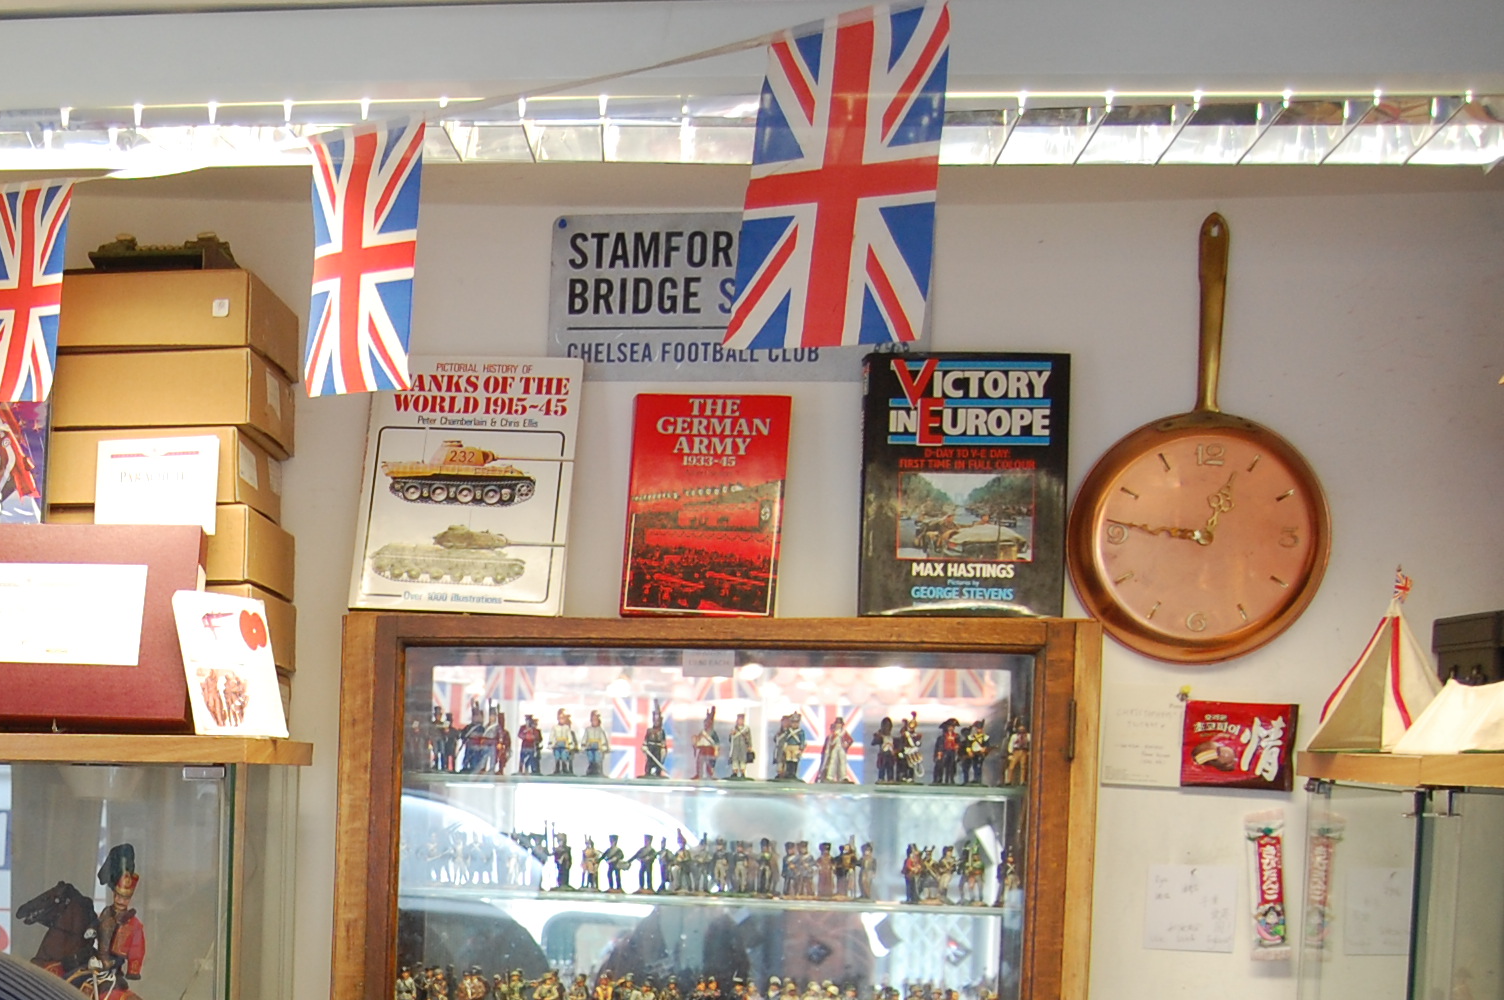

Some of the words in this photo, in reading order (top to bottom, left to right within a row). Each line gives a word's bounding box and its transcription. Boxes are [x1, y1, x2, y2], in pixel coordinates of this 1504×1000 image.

[568, 230, 736, 270] STAMFOR
[568, 277, 702, 315] BRIDGE
[567, 342, 653, 363] CHELSEA
[661, 342, 760, 363] FOOTBALL
[768, 345, 820, 363] CLUB
[436, 362, 478, 373] PICTORIAL
[483, 364, 518, 374] HISTORY
[522, 365, 533, 374] OF
[408, 374, 479, 393] ANKS
[483, 376, 515, 395] OF
[519, 377, 571, 396] THE
[891, 358, 1052, 410] VICTORY
[394, 394, 480, 415] WORLD
[689, 398, 741, 416] THE
[417, 415, 437, 425] Peter
[440, 416, 487, 427] Chamberlain
[490, 418, 497, 427] &
[500, 418, 520, 428] Chris
[656, 417, 771, 436] GERMAN
[889, 410, 917, 433] IN
[916, 398, 1051, 446] EUROPE
[673, 436, 752, 455] ARMY
[924, 448, 954, 458] D-DAY
[957, 449, 969, 458] TO
[1195, 442, 1225, 466] 12
[449, 450, 476, 463] 232
[682, 455, 737, 467] 1933-45
[899, 458, 925, 469] FIRST
[929, 459, 952, 469] TIME
[954, 460, 966, 469] IN
[968, 460, 992, 469] FULL
[996, 460, 1036, 470] COLOUR
[1106, 524, 1129, 545] 9
[911, 562, 944, 577] MAX
[947, 563, 1015, 578] HASTINGS
[911, 586, 961, 599] GEORGE
[962, 587, 1014, 601] STEVENS
[1185, 610, 1207, 632] 6
[1240, 715, 1287, 782] 情
